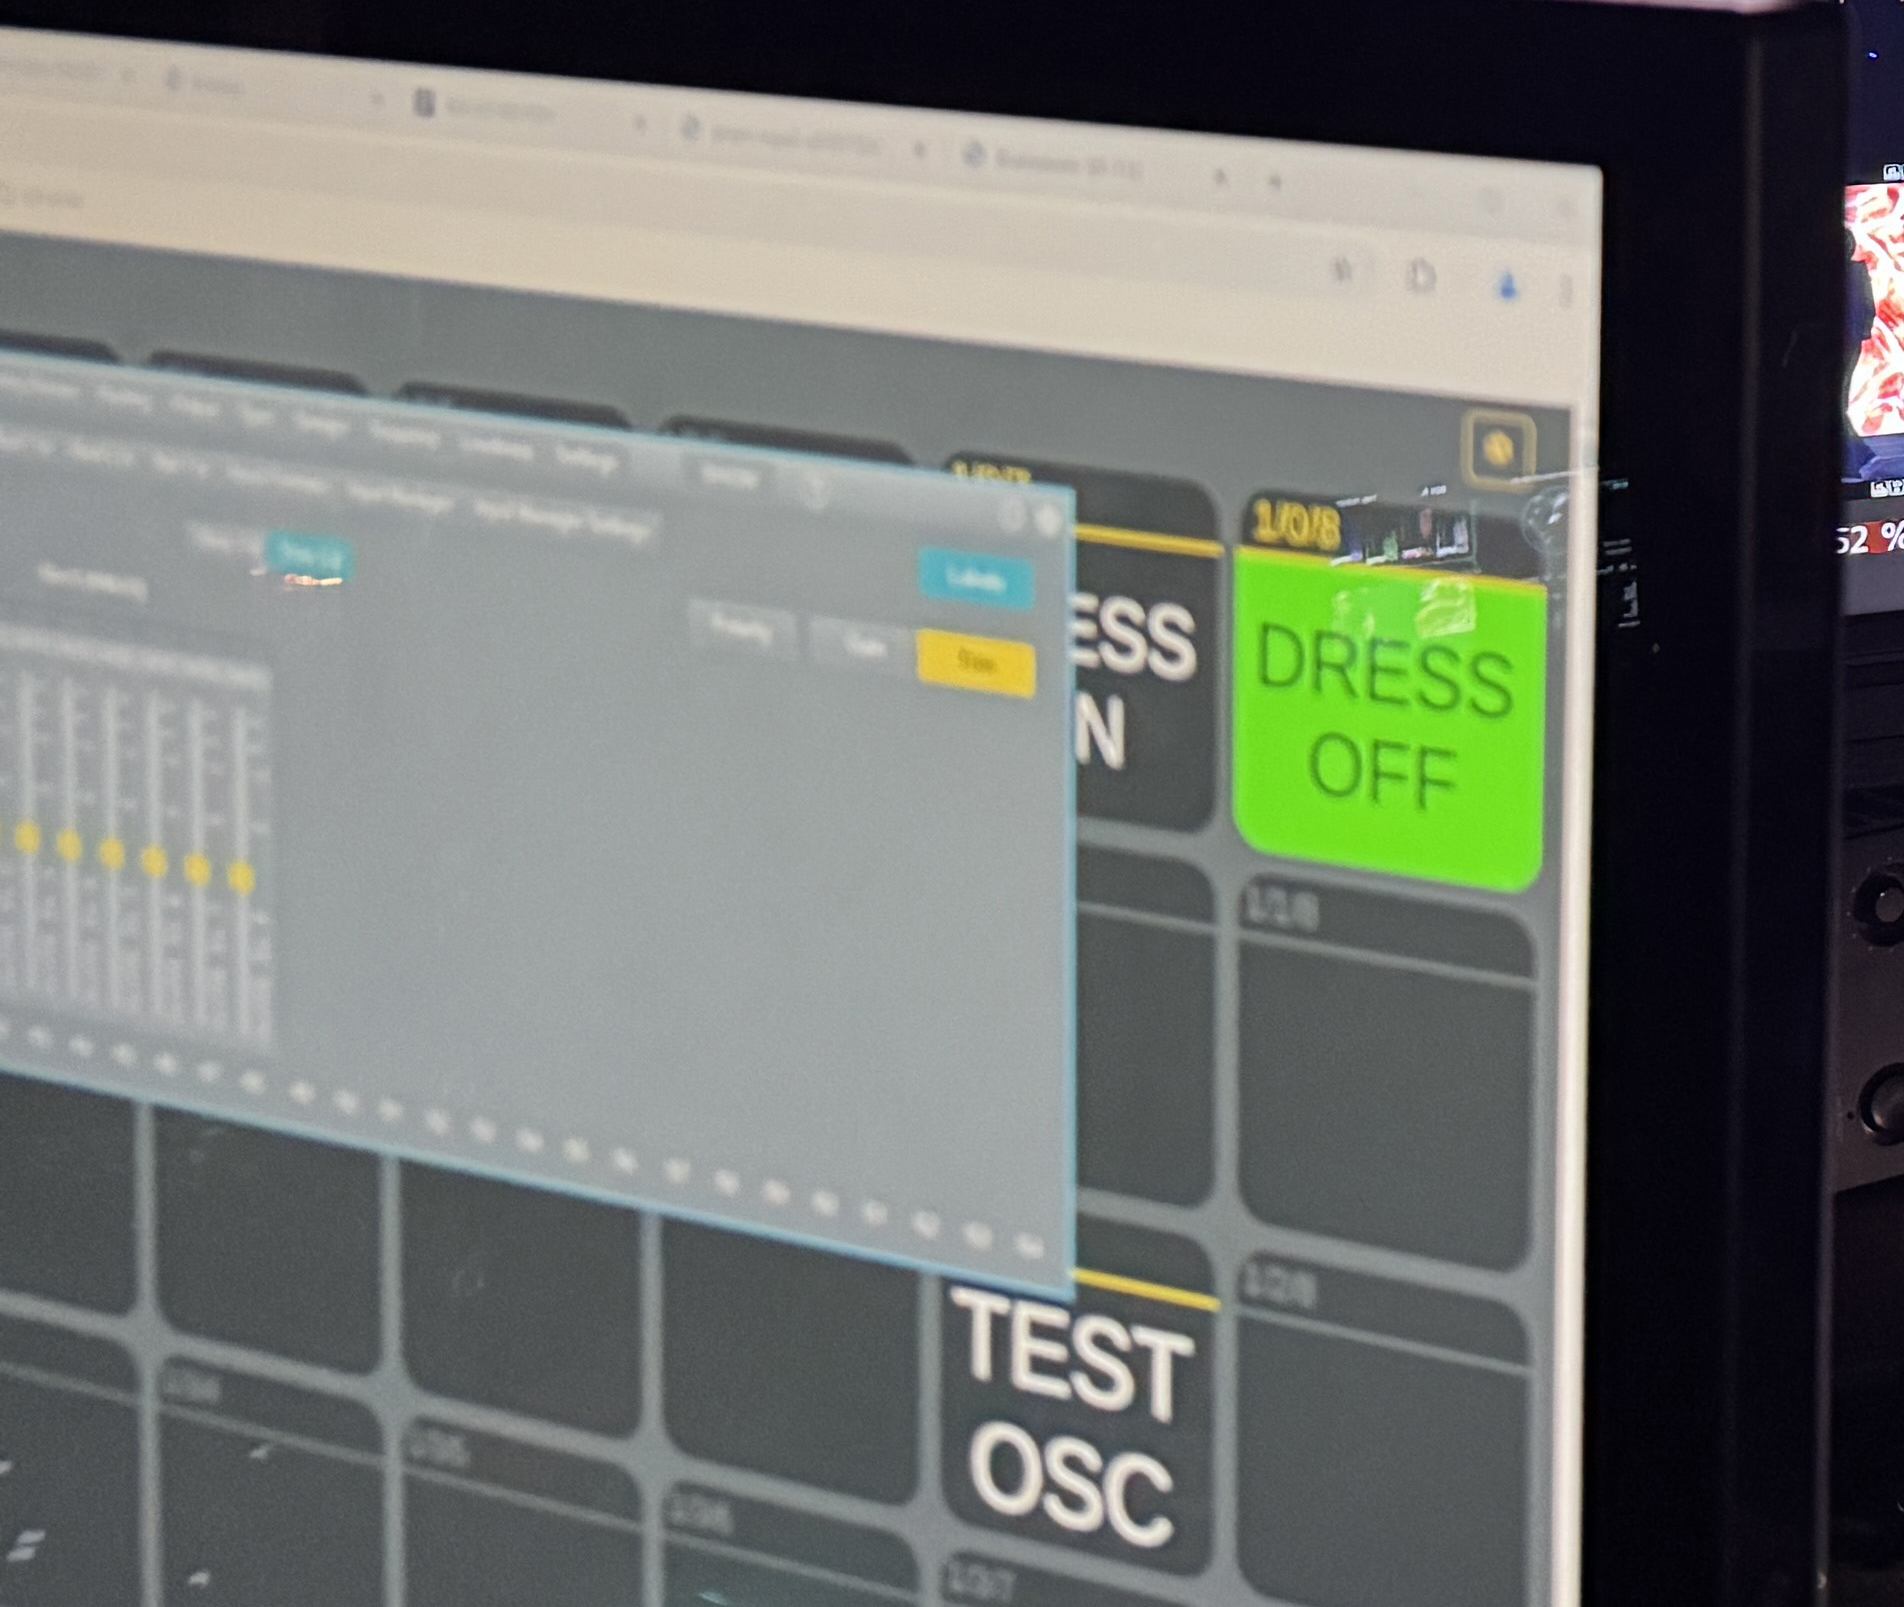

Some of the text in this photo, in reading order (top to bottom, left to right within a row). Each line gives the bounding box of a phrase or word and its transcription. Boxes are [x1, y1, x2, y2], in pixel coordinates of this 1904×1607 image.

[1257, 621, 1515, 720] DRESS
[1308, 730, 1458, 811] OFF
[950, 1286, 1195, 1424] TEST
[971, 1421, 1174, 1549] OSC
